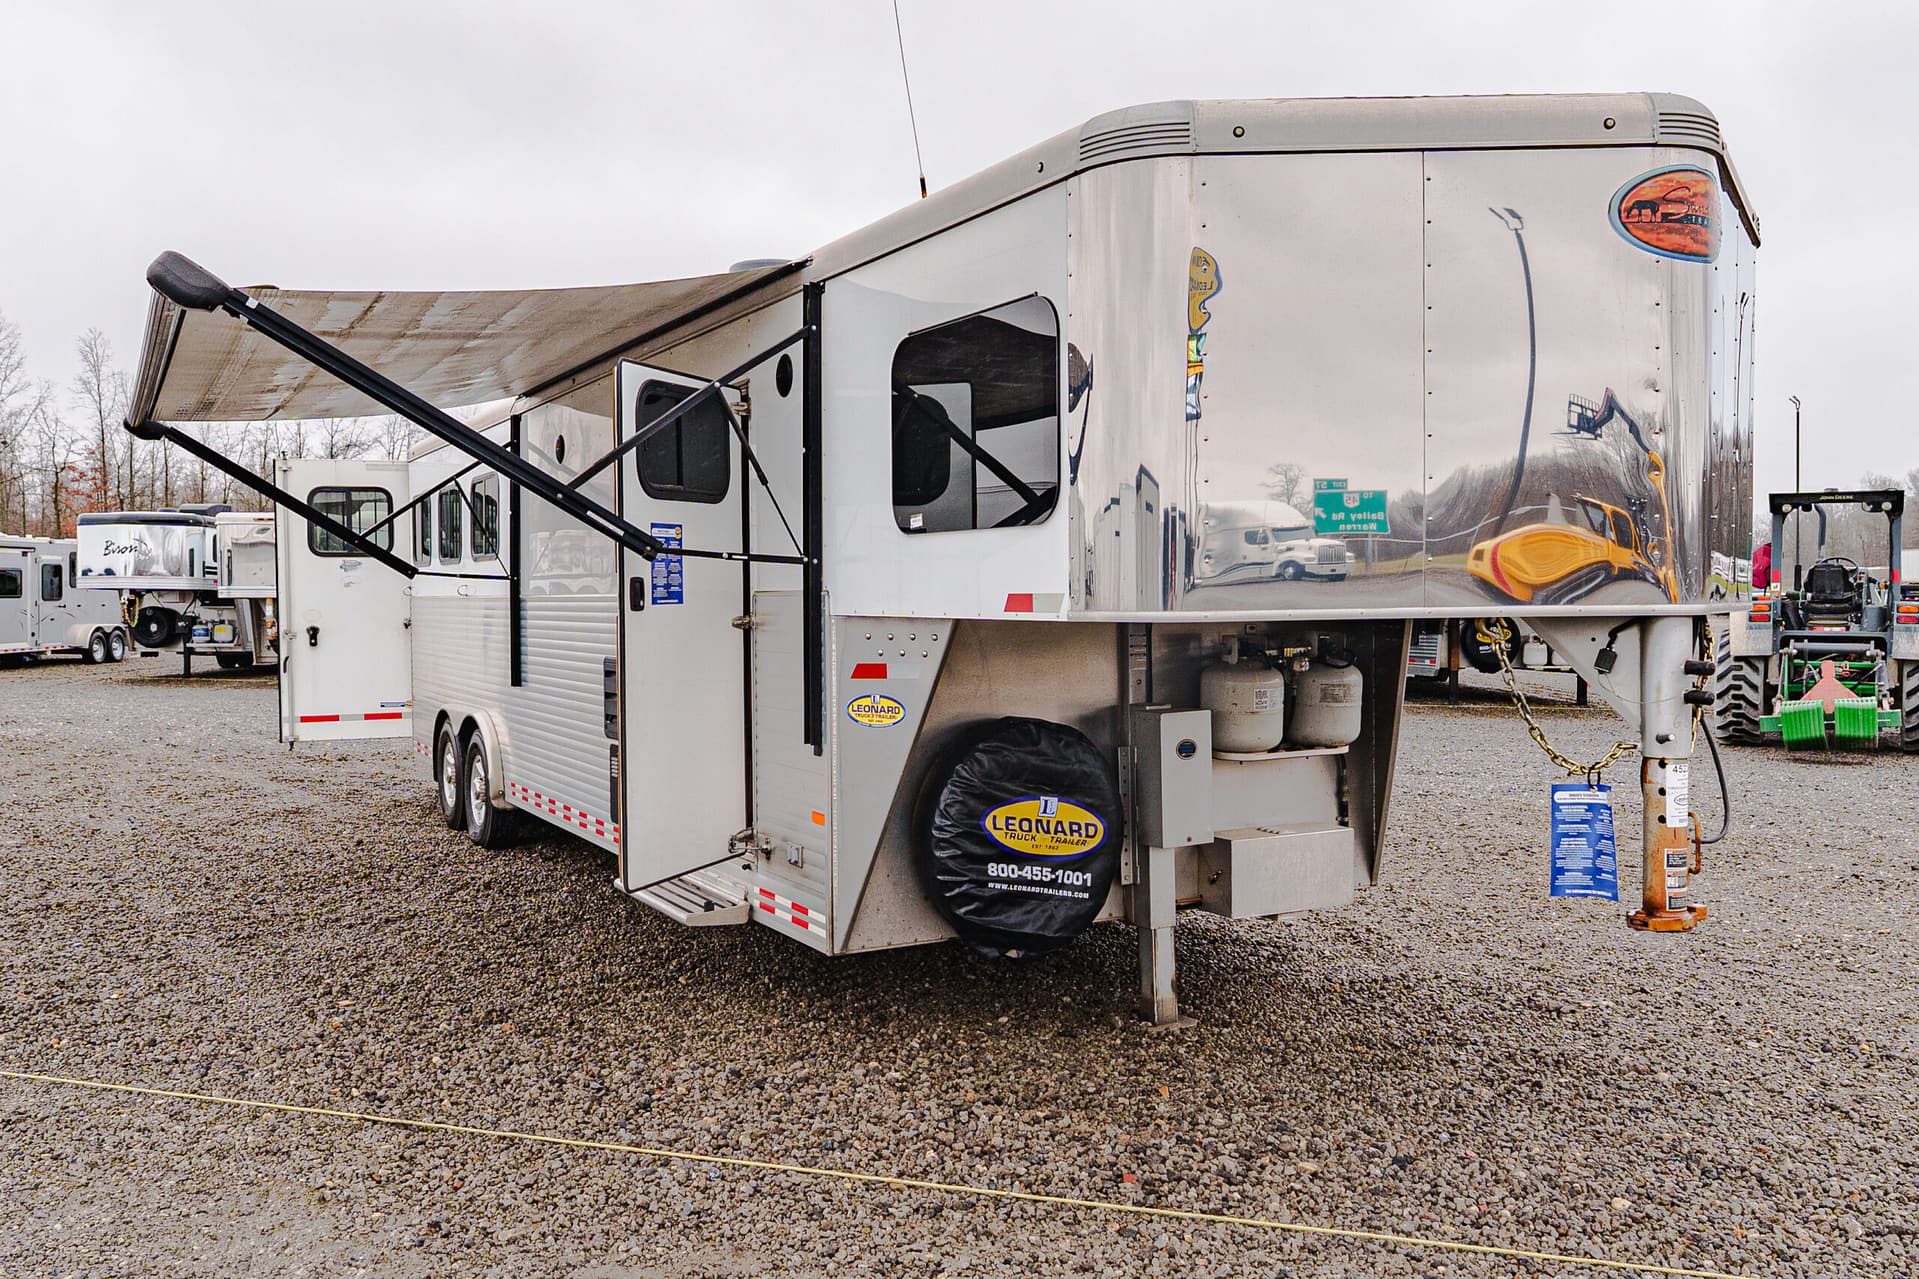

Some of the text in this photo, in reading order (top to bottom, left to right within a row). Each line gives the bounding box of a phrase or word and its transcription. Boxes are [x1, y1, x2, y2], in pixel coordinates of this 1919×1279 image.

[103, 539, 138, 557] Bison
[851, 703, 900, 715] LEONARD
[992, 815, 1098, 839] LEONARD
[1004, 832, 1037, 842] TRUCK
[1050, 836, 1087, 847] TRAILER
[987, 862, 1092, 887] 800-455-1001
[988, 882, 1089, 899] WWW.LEONARDTRAILERS.COM
